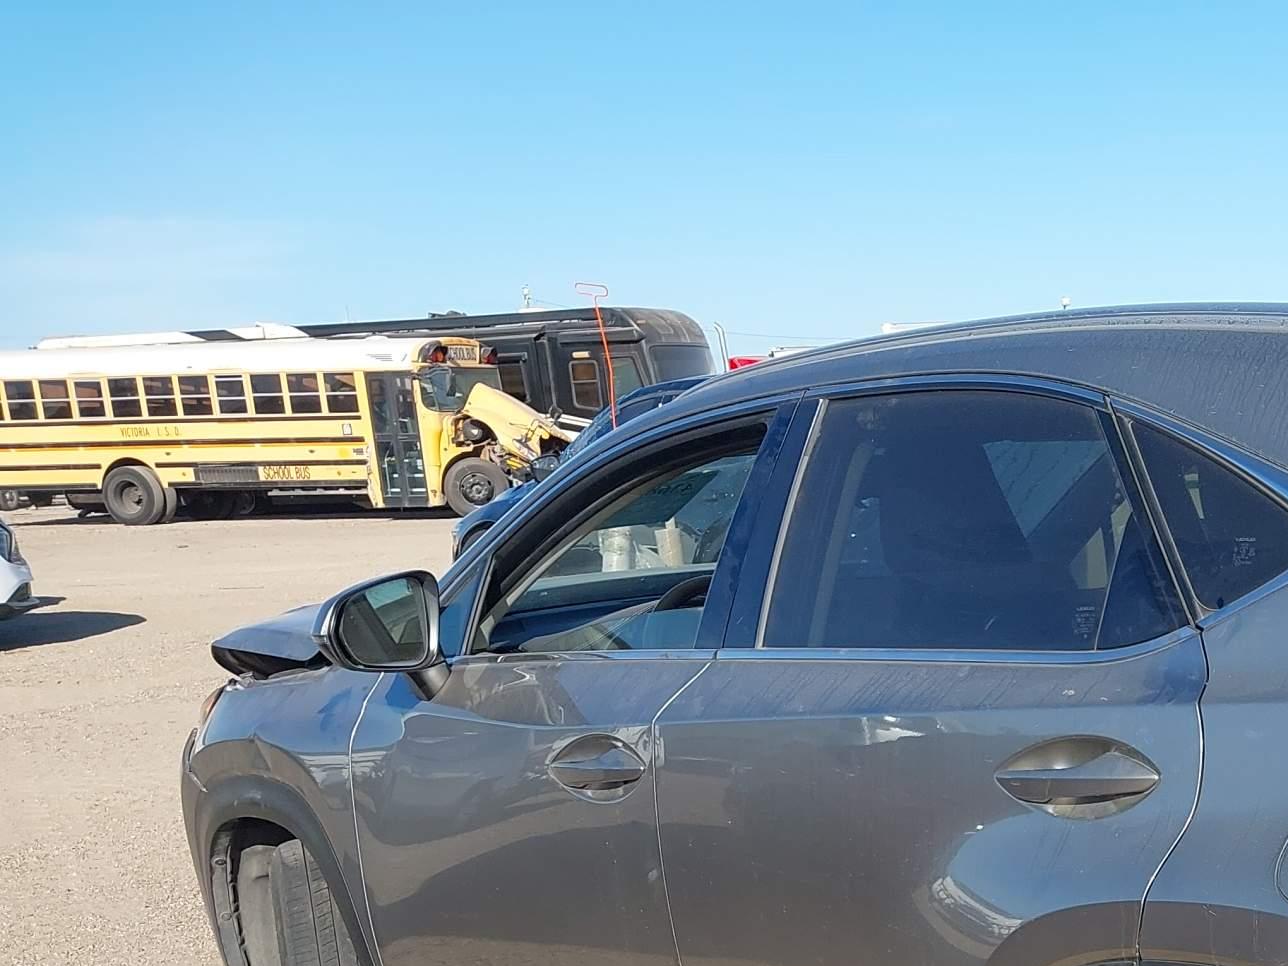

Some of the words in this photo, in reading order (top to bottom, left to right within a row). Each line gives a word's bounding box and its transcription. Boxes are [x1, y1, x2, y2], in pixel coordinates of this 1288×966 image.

[120, 426, 150, 438] VICTORIA
[263, 466, 294, 480] SCHOOL
[295, 466, 311, 480] BUS
